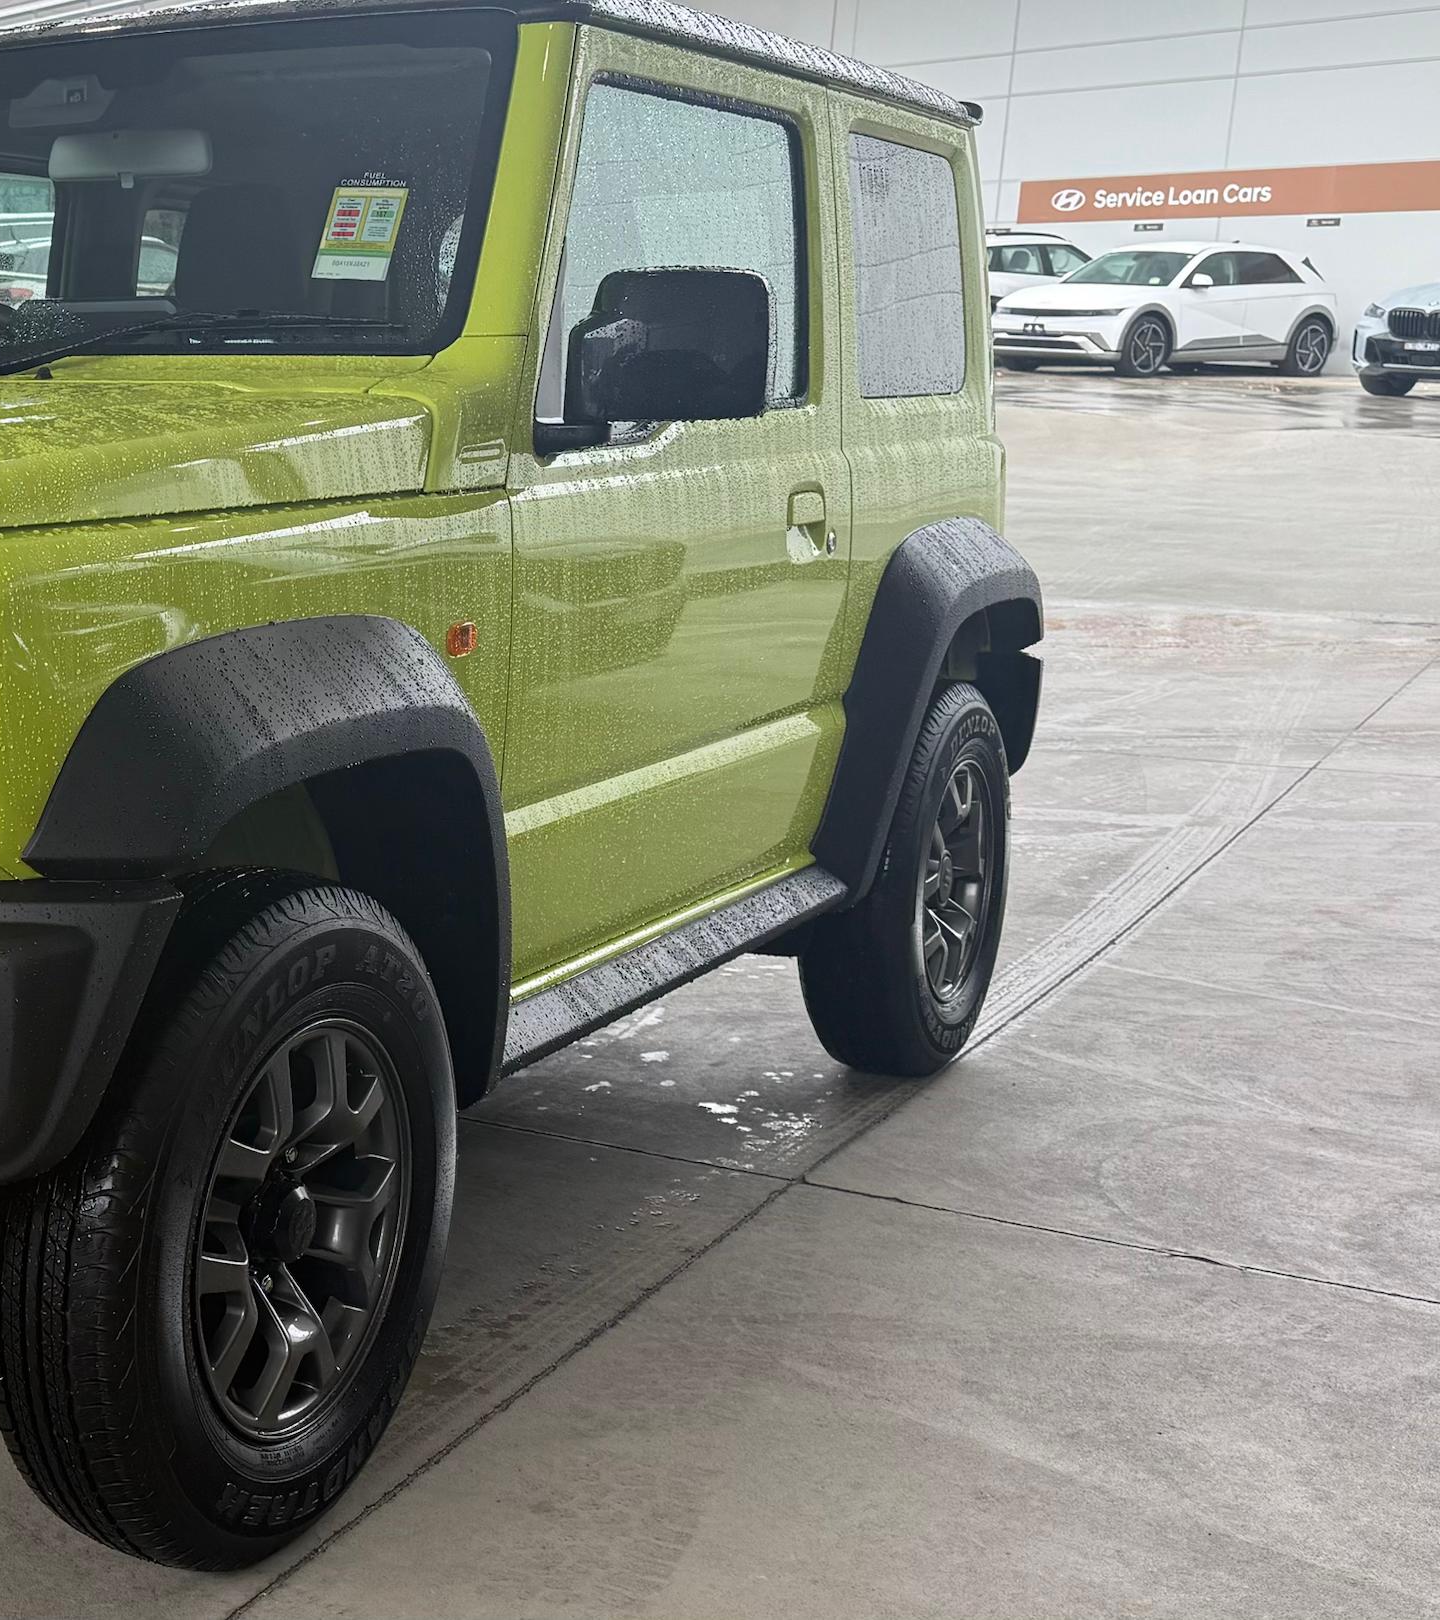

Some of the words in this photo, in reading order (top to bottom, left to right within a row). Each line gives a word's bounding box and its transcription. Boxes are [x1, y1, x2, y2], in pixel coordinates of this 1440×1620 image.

[340, 179, 407, 187] CONSUMPTION
[1093, 186, 1165, 209] Service
[1168, 185, 1219, 206] Loan
[1223, 183, 1272, 203] Cars
[950, 714, 996, 763] DUNLOP
